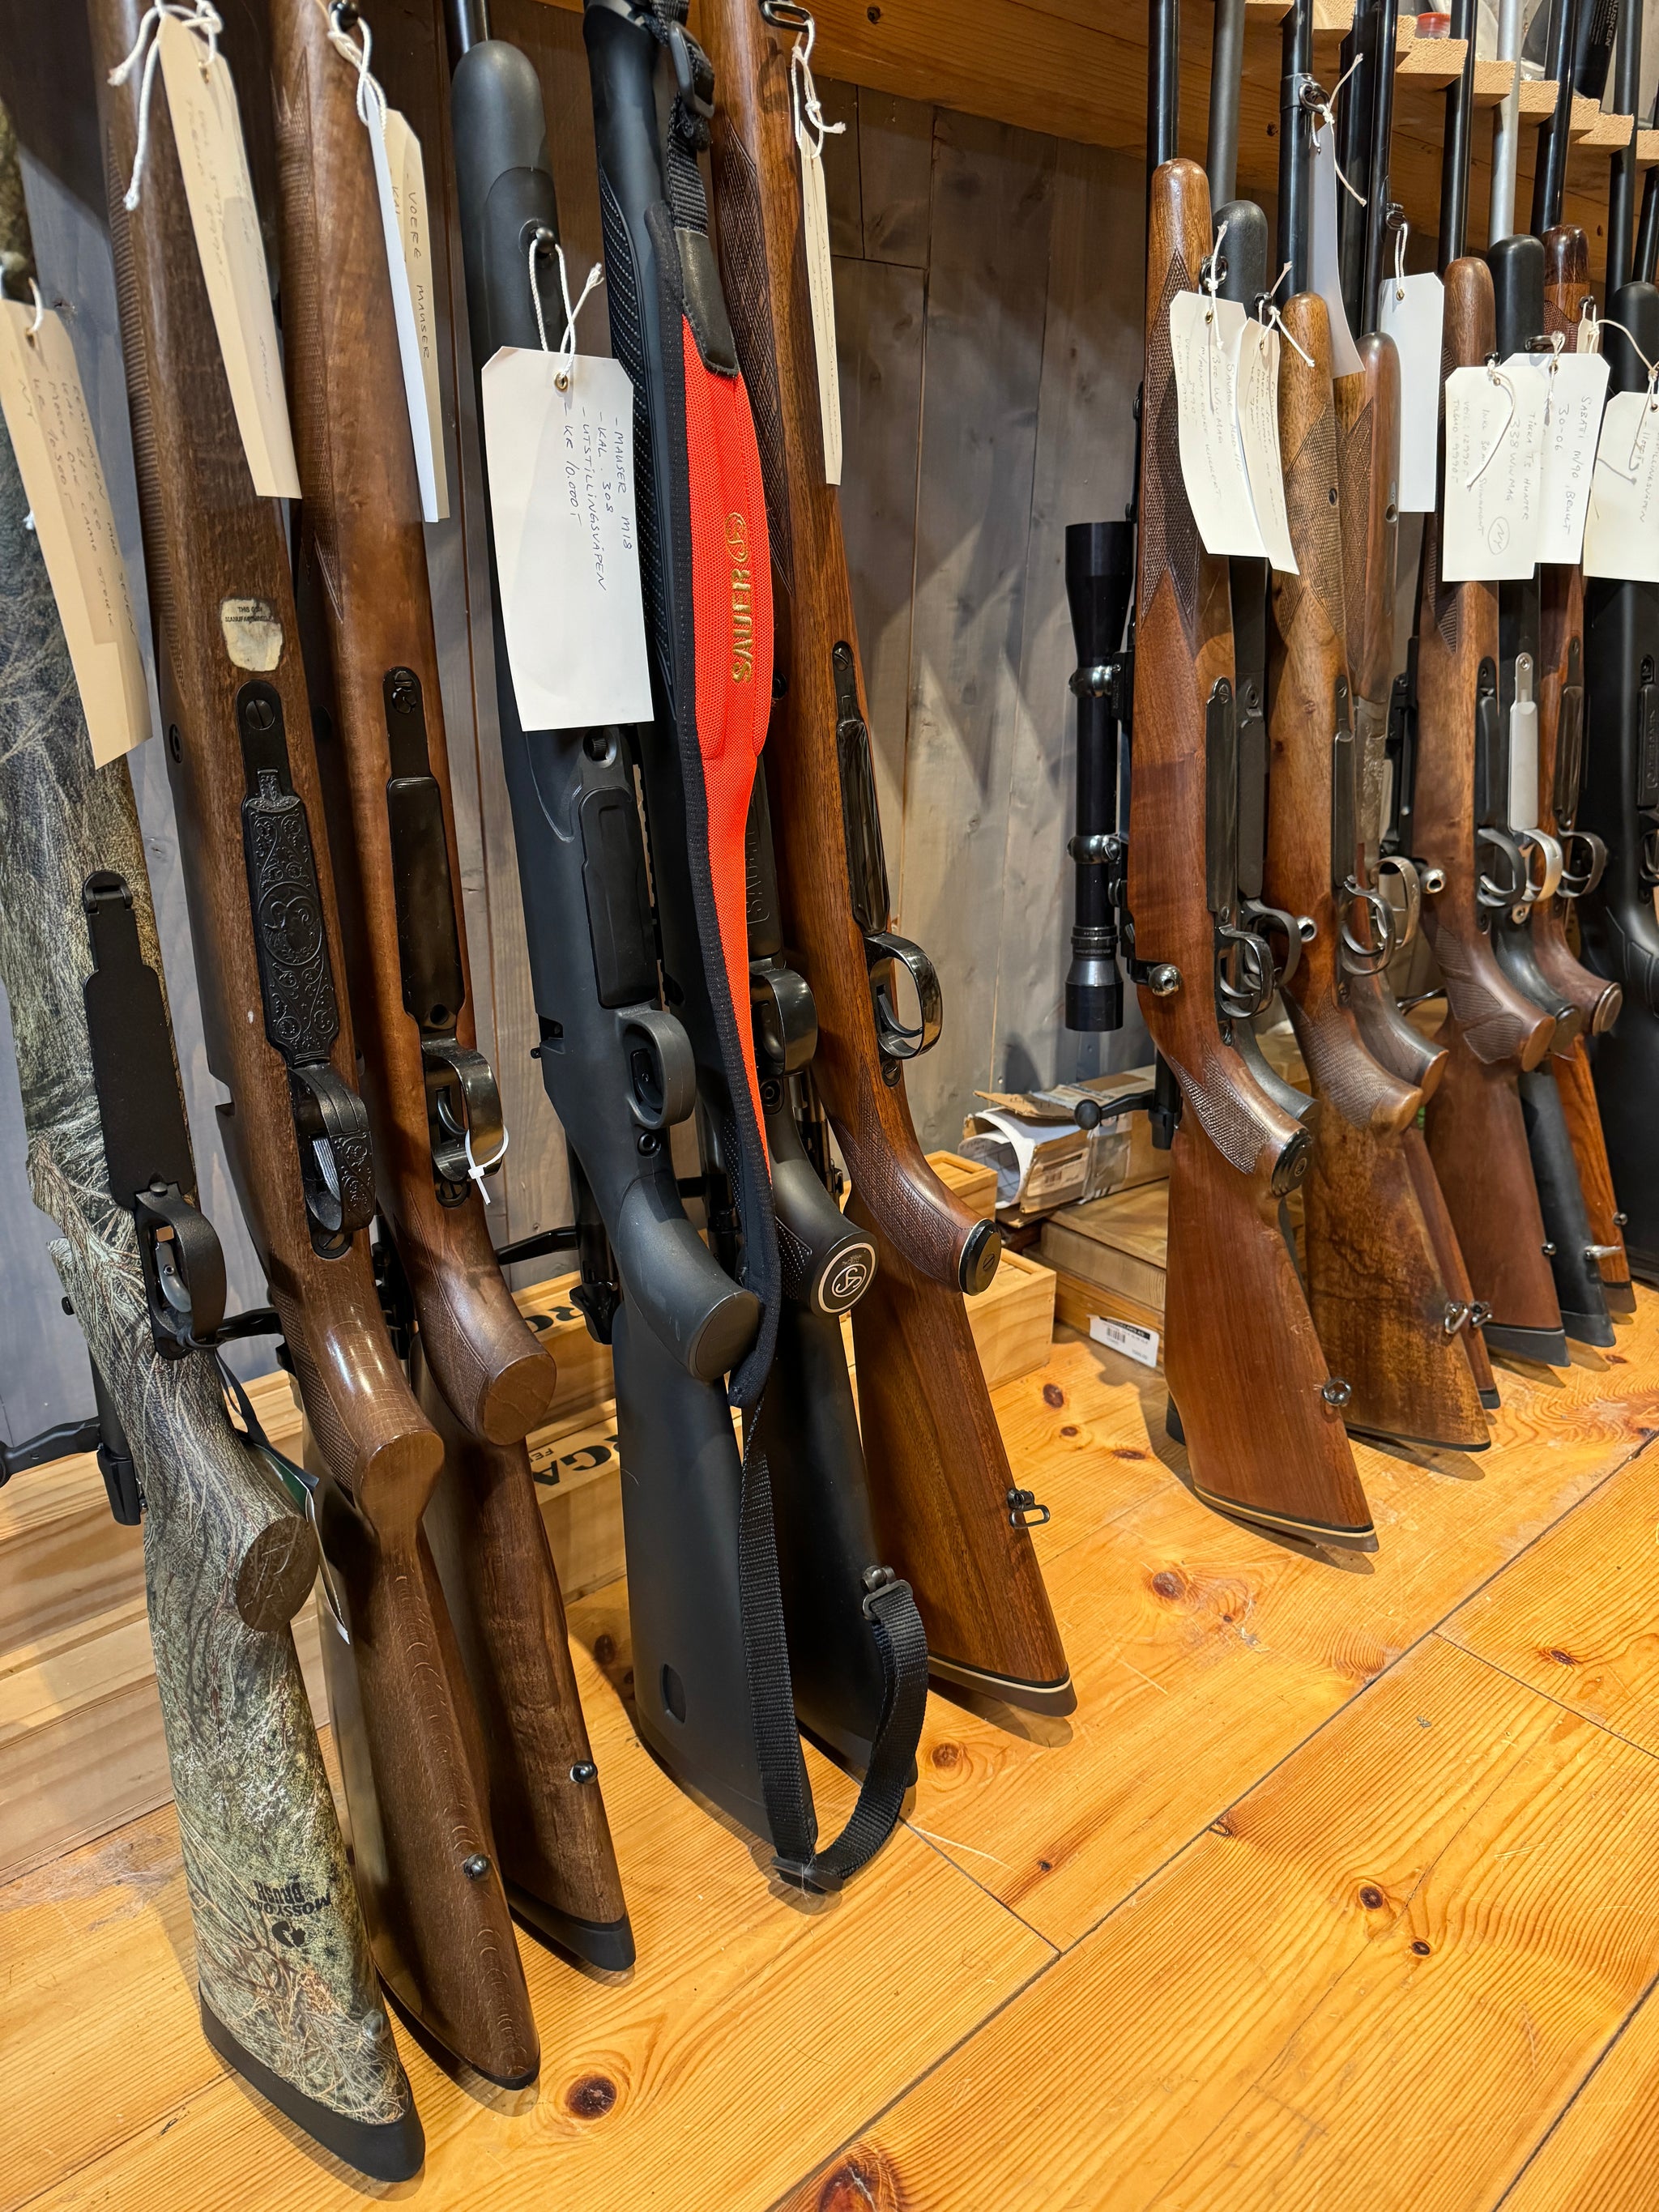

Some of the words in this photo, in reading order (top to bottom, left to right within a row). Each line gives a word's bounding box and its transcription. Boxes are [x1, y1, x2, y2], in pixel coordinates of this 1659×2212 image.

[416, 284, 429, 359] MAUSER
[563, 424, 574, 450] KR
[1509, 419, 1520, 449] 338
[1555, 403, 1570, 451] 30-06
[614, 431, 627, 493] MAUSER
[621, 516, 633, 550] M18
[731, 568, 753, 684] SAUER
[253, 1879, 306, 1905] BRUSH
[275, 1890, 331, 1918] MOSSY
